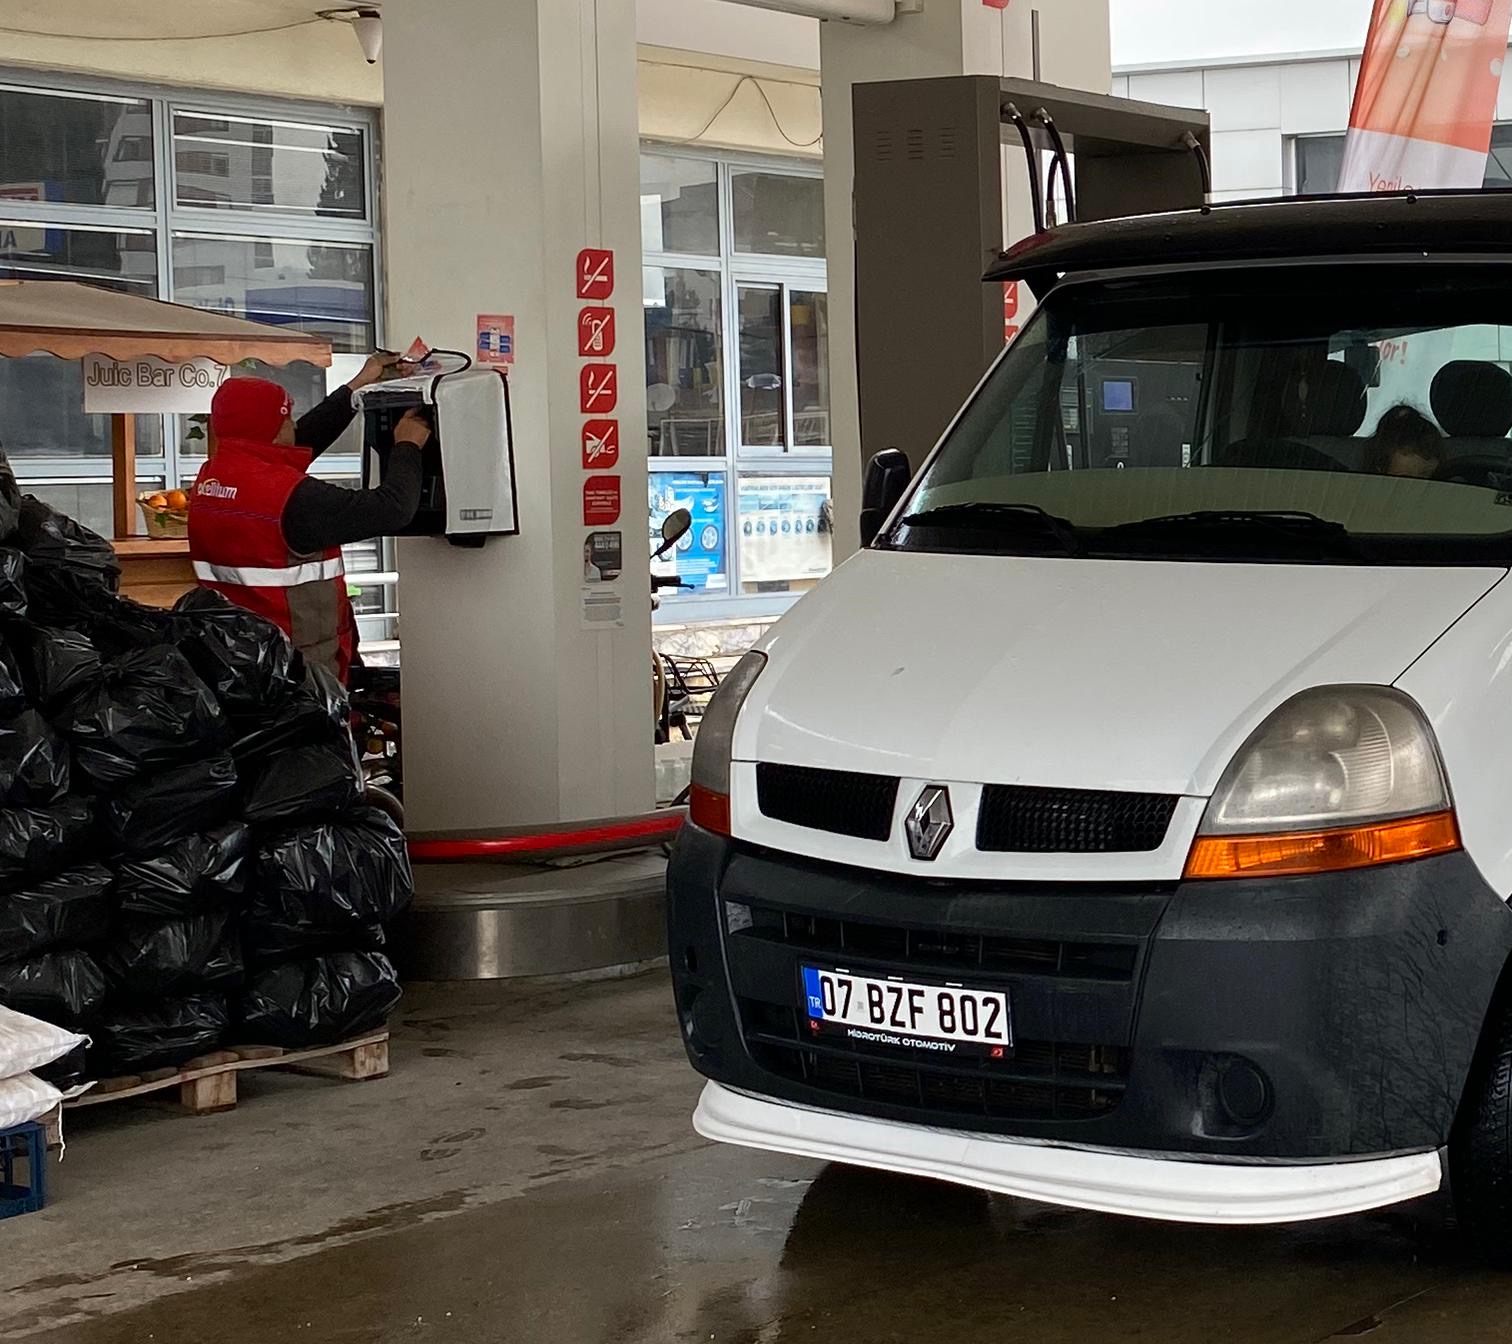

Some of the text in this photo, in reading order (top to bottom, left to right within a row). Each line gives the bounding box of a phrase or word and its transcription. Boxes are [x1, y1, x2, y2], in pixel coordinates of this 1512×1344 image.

[1369, 171, 1412, 192] Yenil
[87, 360, 131, 387] Juic
[136, 361, 174, 387] Bar
[808, 994, 821, 1009] TR
[820, 975, 1003, 1040] 07 BZF 802
